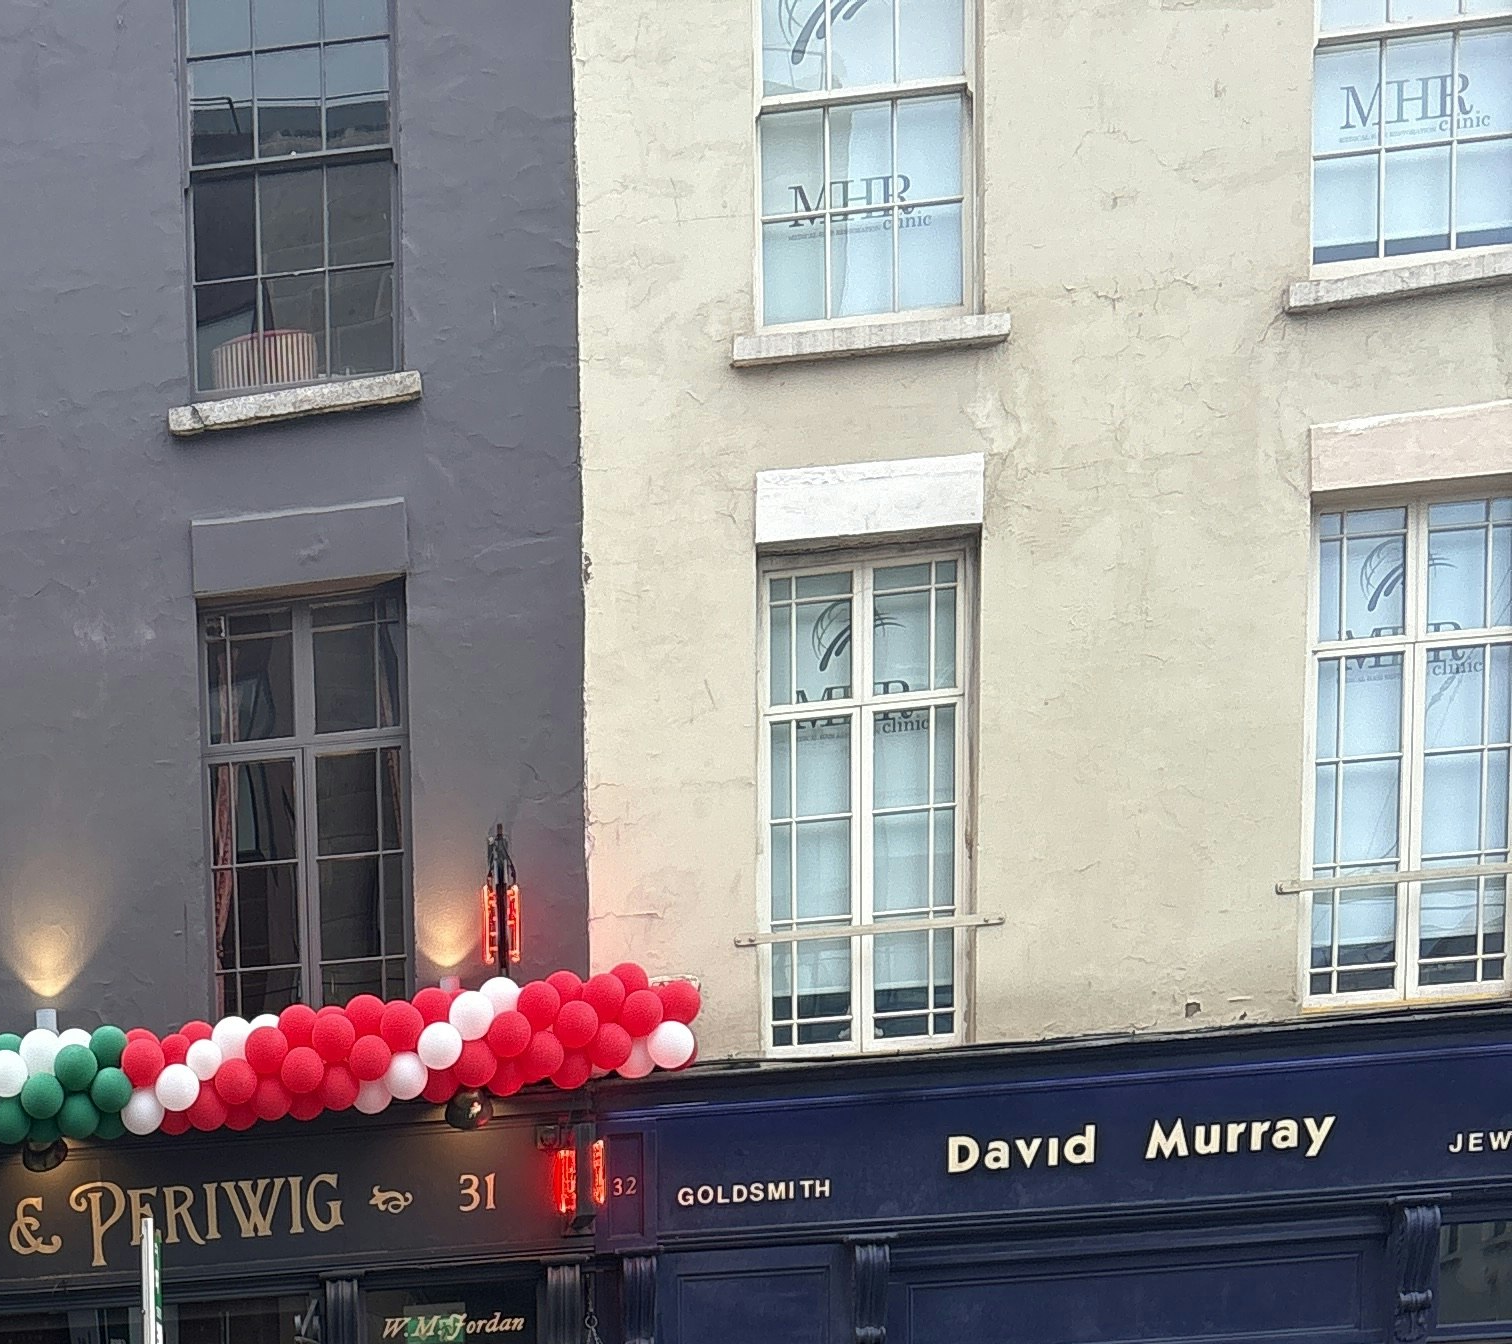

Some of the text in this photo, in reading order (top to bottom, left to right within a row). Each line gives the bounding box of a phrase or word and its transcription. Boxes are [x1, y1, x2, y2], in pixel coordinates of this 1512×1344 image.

[1439, 110, 1491, 132] cinic
[882, 210, 933, 231] cinic
[947, 1114, 1337, 1174] David Murray
[612, 1176, 638, 1196] 32
[677, 1178, 831, 1206] GOLDSMITH
[8, 1196, 63, 1255] &
[69, 1173, 345, 1267] PERIWIG
[459, 1172, 497, 1212] 31
